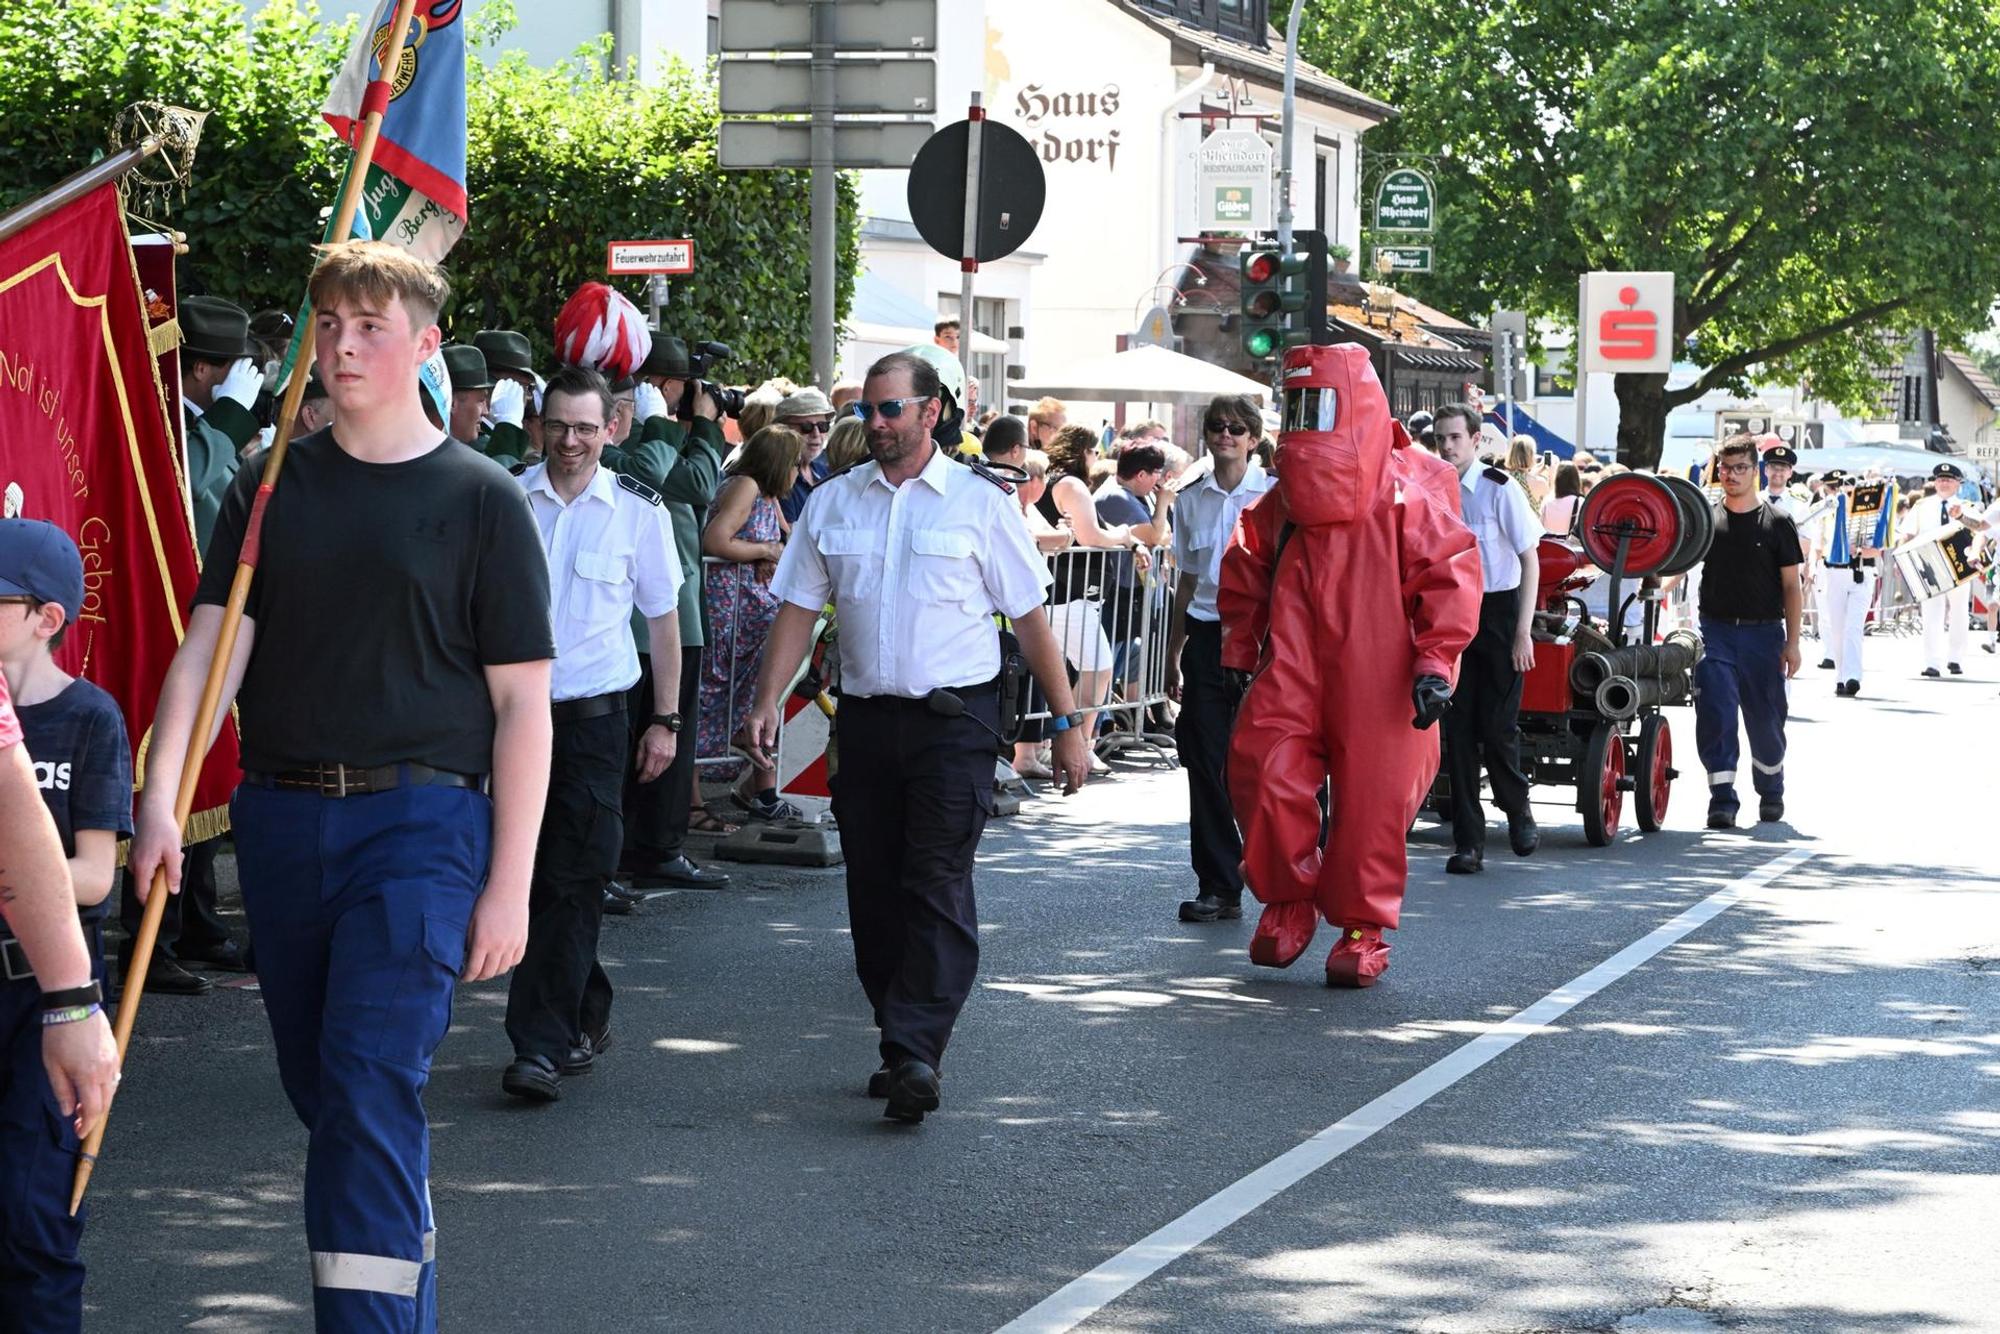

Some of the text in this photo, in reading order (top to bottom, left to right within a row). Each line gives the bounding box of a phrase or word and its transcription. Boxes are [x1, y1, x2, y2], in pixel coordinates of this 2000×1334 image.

[1014, 83, 1120, 128] Haus
[1203, 164, 1265, 173] RESTAURANT
[362, 173, 400, 221] Jug
[1391, 193, 1418, 207] Haus
[1217, 200, 1250, 212] Gilden
[1380, 206, 1428, 220] Rheindorf
[615, 252, 685, 264] Feuerwehrzufahrt
[38, 376, 61, 420] ist
[56, 417, 89, 499] unser
[79, 516, 113, 624] Gebot
